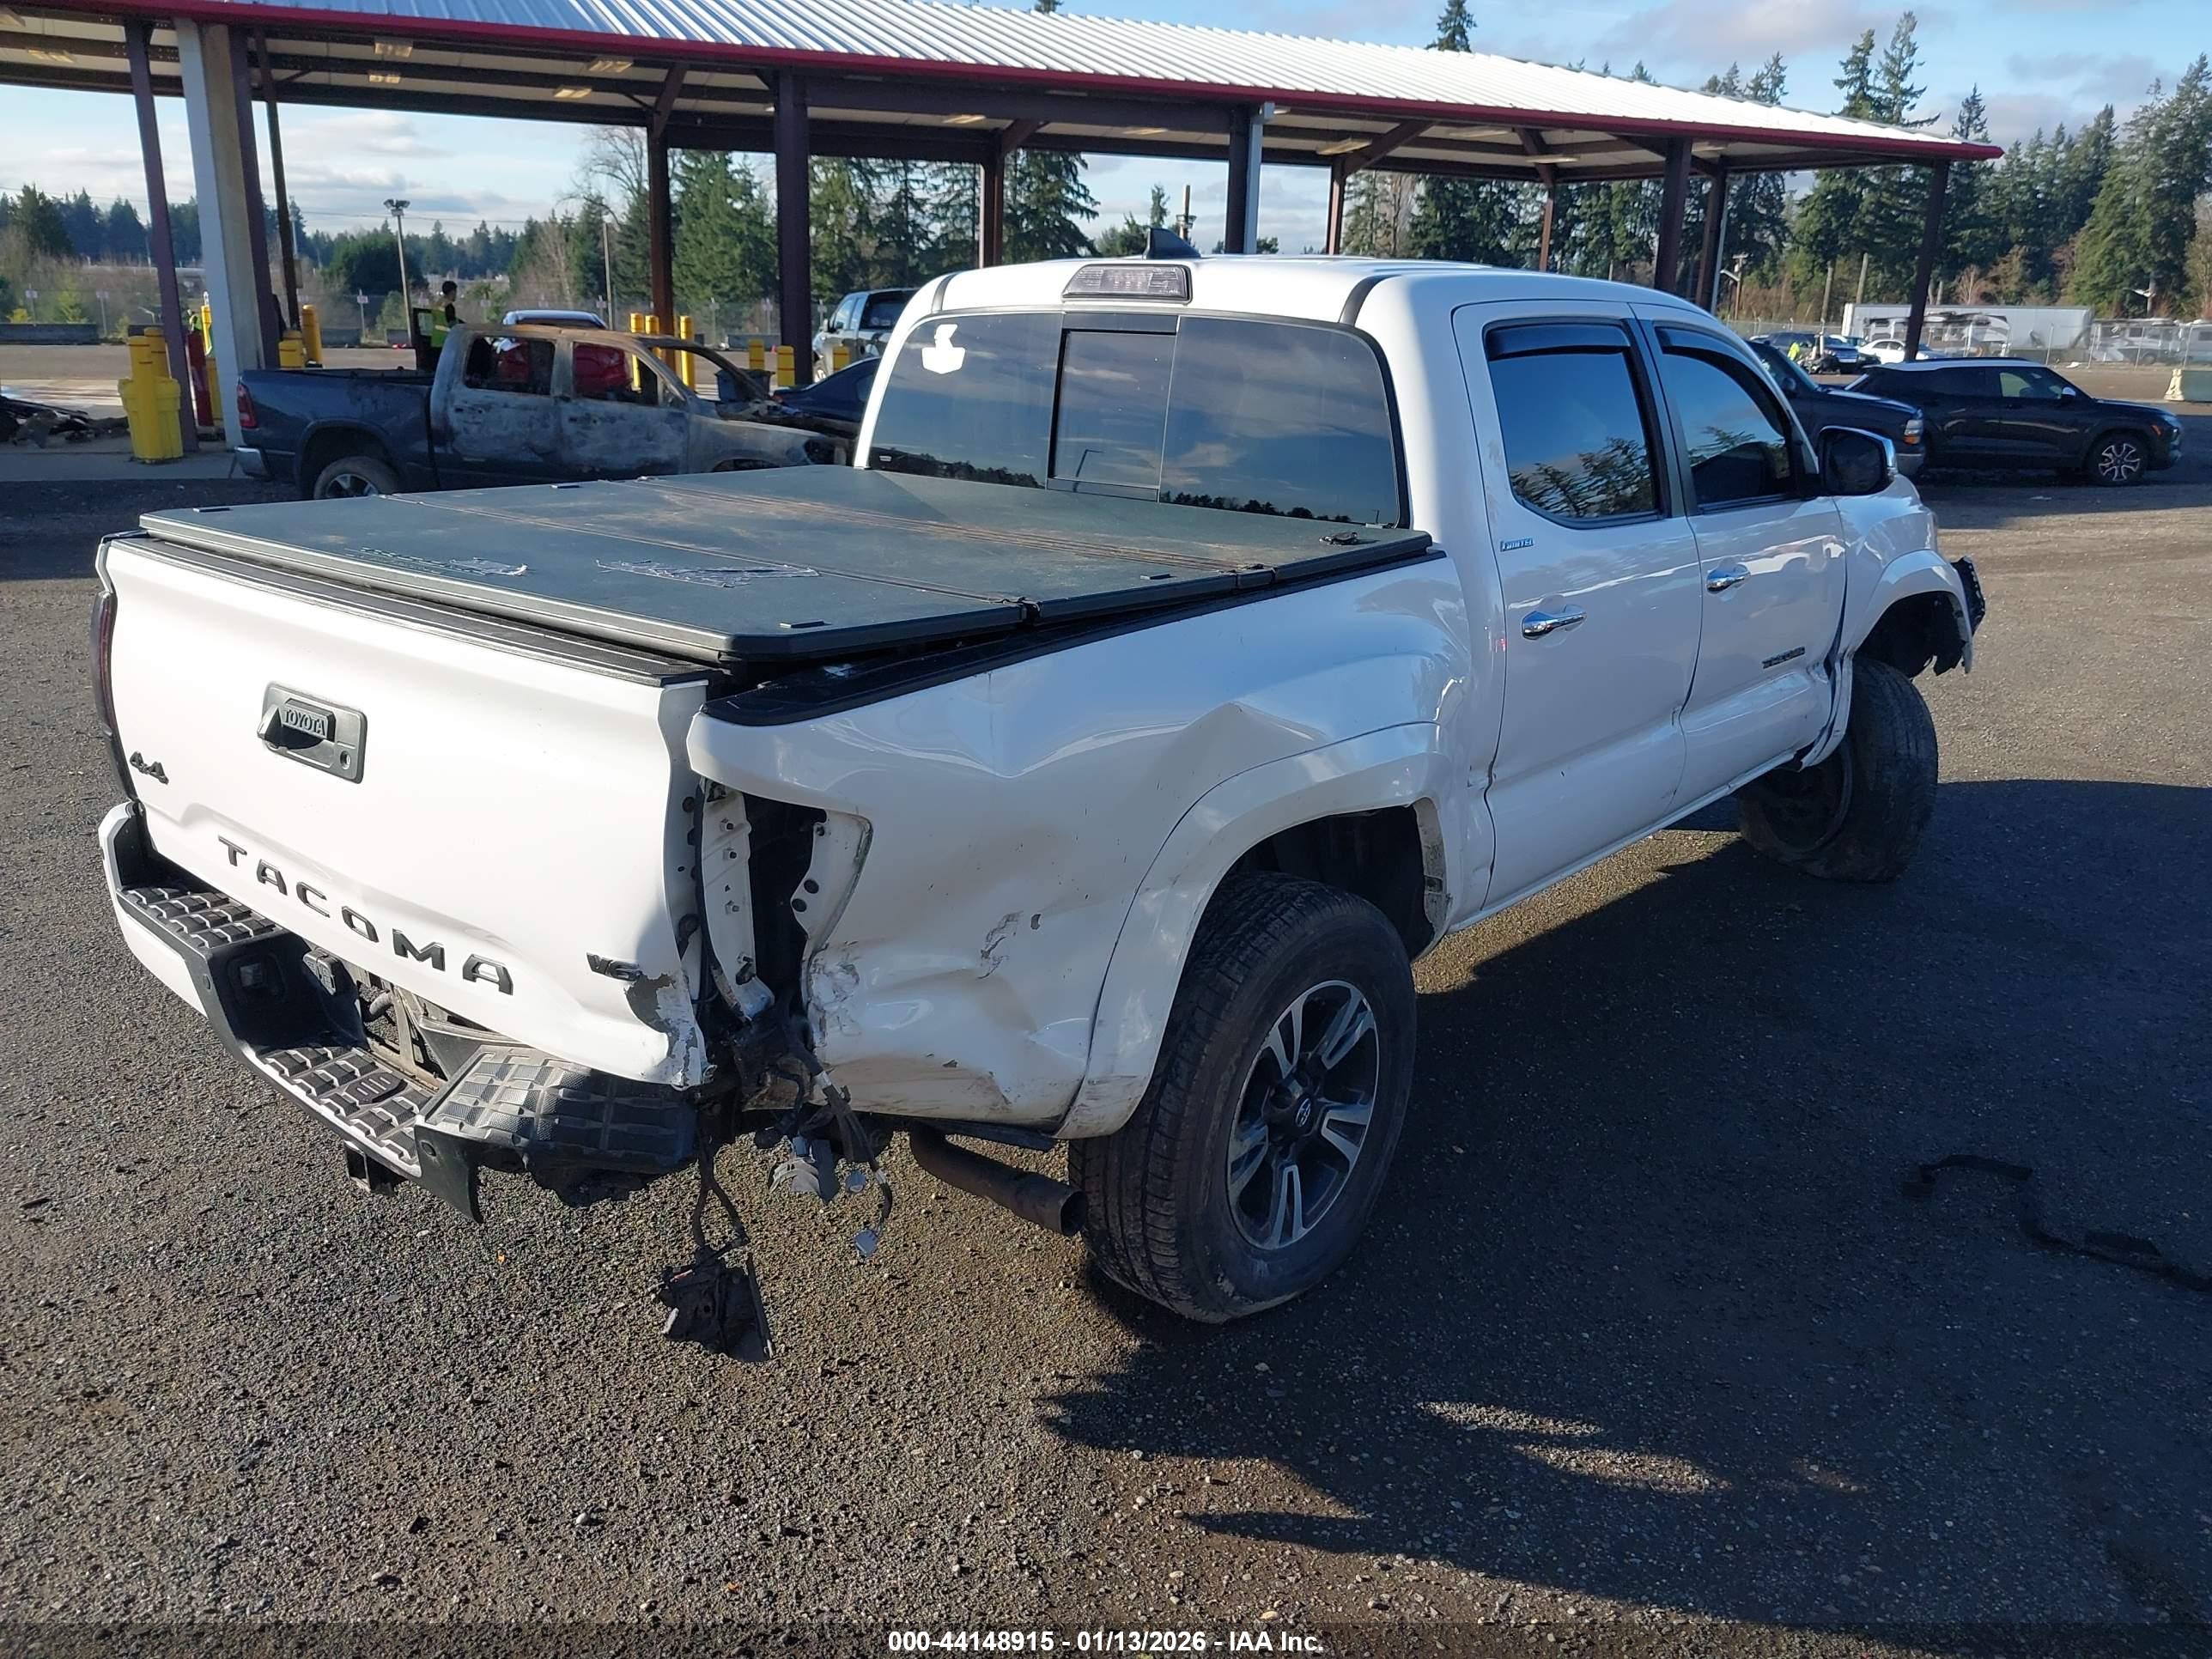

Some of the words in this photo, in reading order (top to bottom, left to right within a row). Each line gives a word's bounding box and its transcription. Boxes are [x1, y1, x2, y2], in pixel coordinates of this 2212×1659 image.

[283, 708, 326, 736] TOYOTA
[217, 835, 514, 996] TACOMA
[586, 951, 643, 982] V6
